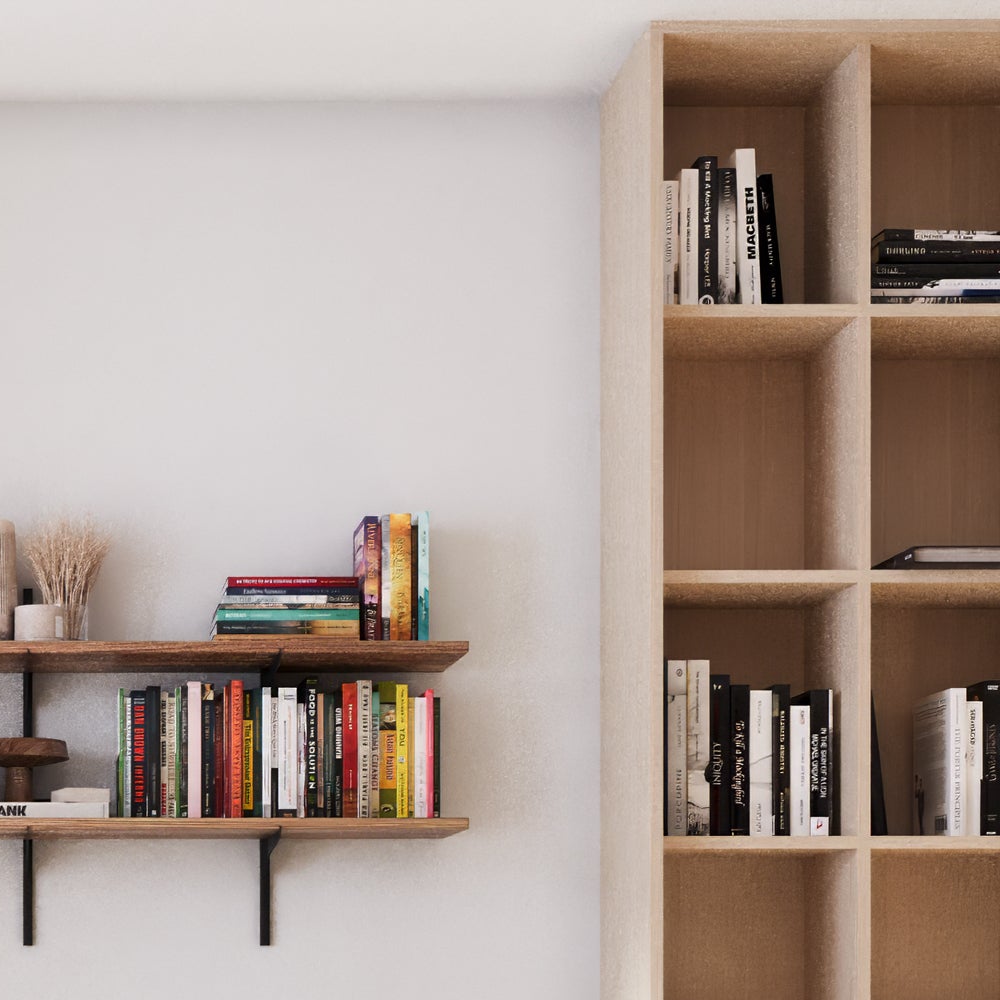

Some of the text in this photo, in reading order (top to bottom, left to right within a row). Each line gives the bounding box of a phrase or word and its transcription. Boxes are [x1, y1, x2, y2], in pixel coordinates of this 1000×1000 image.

[744, 187, 756, 260] MACBETH
[735, 720, 745, 731] To
[820, 727, 828, 735] IN
[133, 705, 144, 803] DAN BROWN INFERNO
[732, 733, 746, 750] Kill
[820, 735, 828, 749] THE
[712, 742, 724, 785] INIQUITY
[731, 756, 746, 807] Mockingbird
